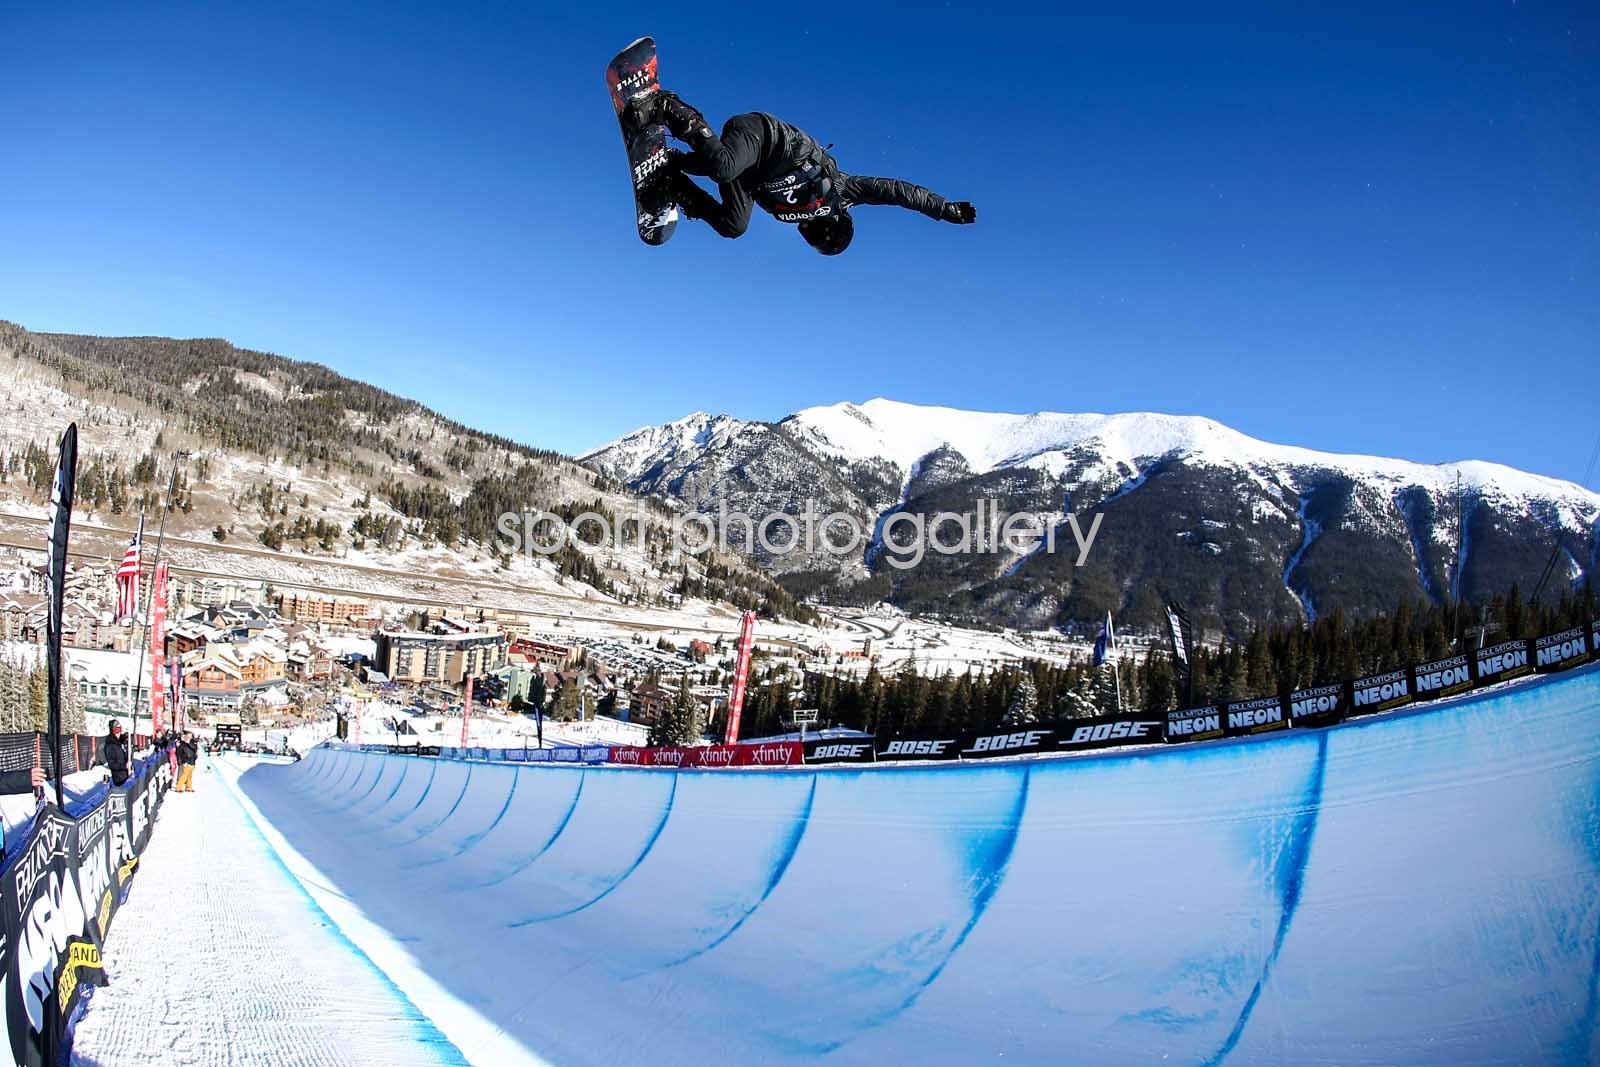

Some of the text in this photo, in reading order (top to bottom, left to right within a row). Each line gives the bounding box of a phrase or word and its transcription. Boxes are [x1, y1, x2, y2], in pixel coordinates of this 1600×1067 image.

[634, 75, 649, 88] AIR
[634, 148, 664, 175] SPACE
[783, 190, 798, 204] 2
[778, 212, 815, 221] TOYOTA
[1536, 637, 1585, 666] NEON
[1477, 650, 1527, 677] NEON
[1416, 665, 1469, 692] NEON
[1354, 680, 1408, 706] NEON
[1168, 715, 1220, 736] NEON
[1228, 706, 1282, 728] NEON
[962, 730, 1053, 752] BOSE
[1059, 721, 1163, 744] BOSE
[614, 748, 640, 763] xfinity
[654, 747, 684, 765] xfinity
[699, 746, 734, 766] xfinity
[752, 745, 792, 765] xfinity
[806, 744, 873, 759] BOSE
[877, 740, 955, 756] BOSE
